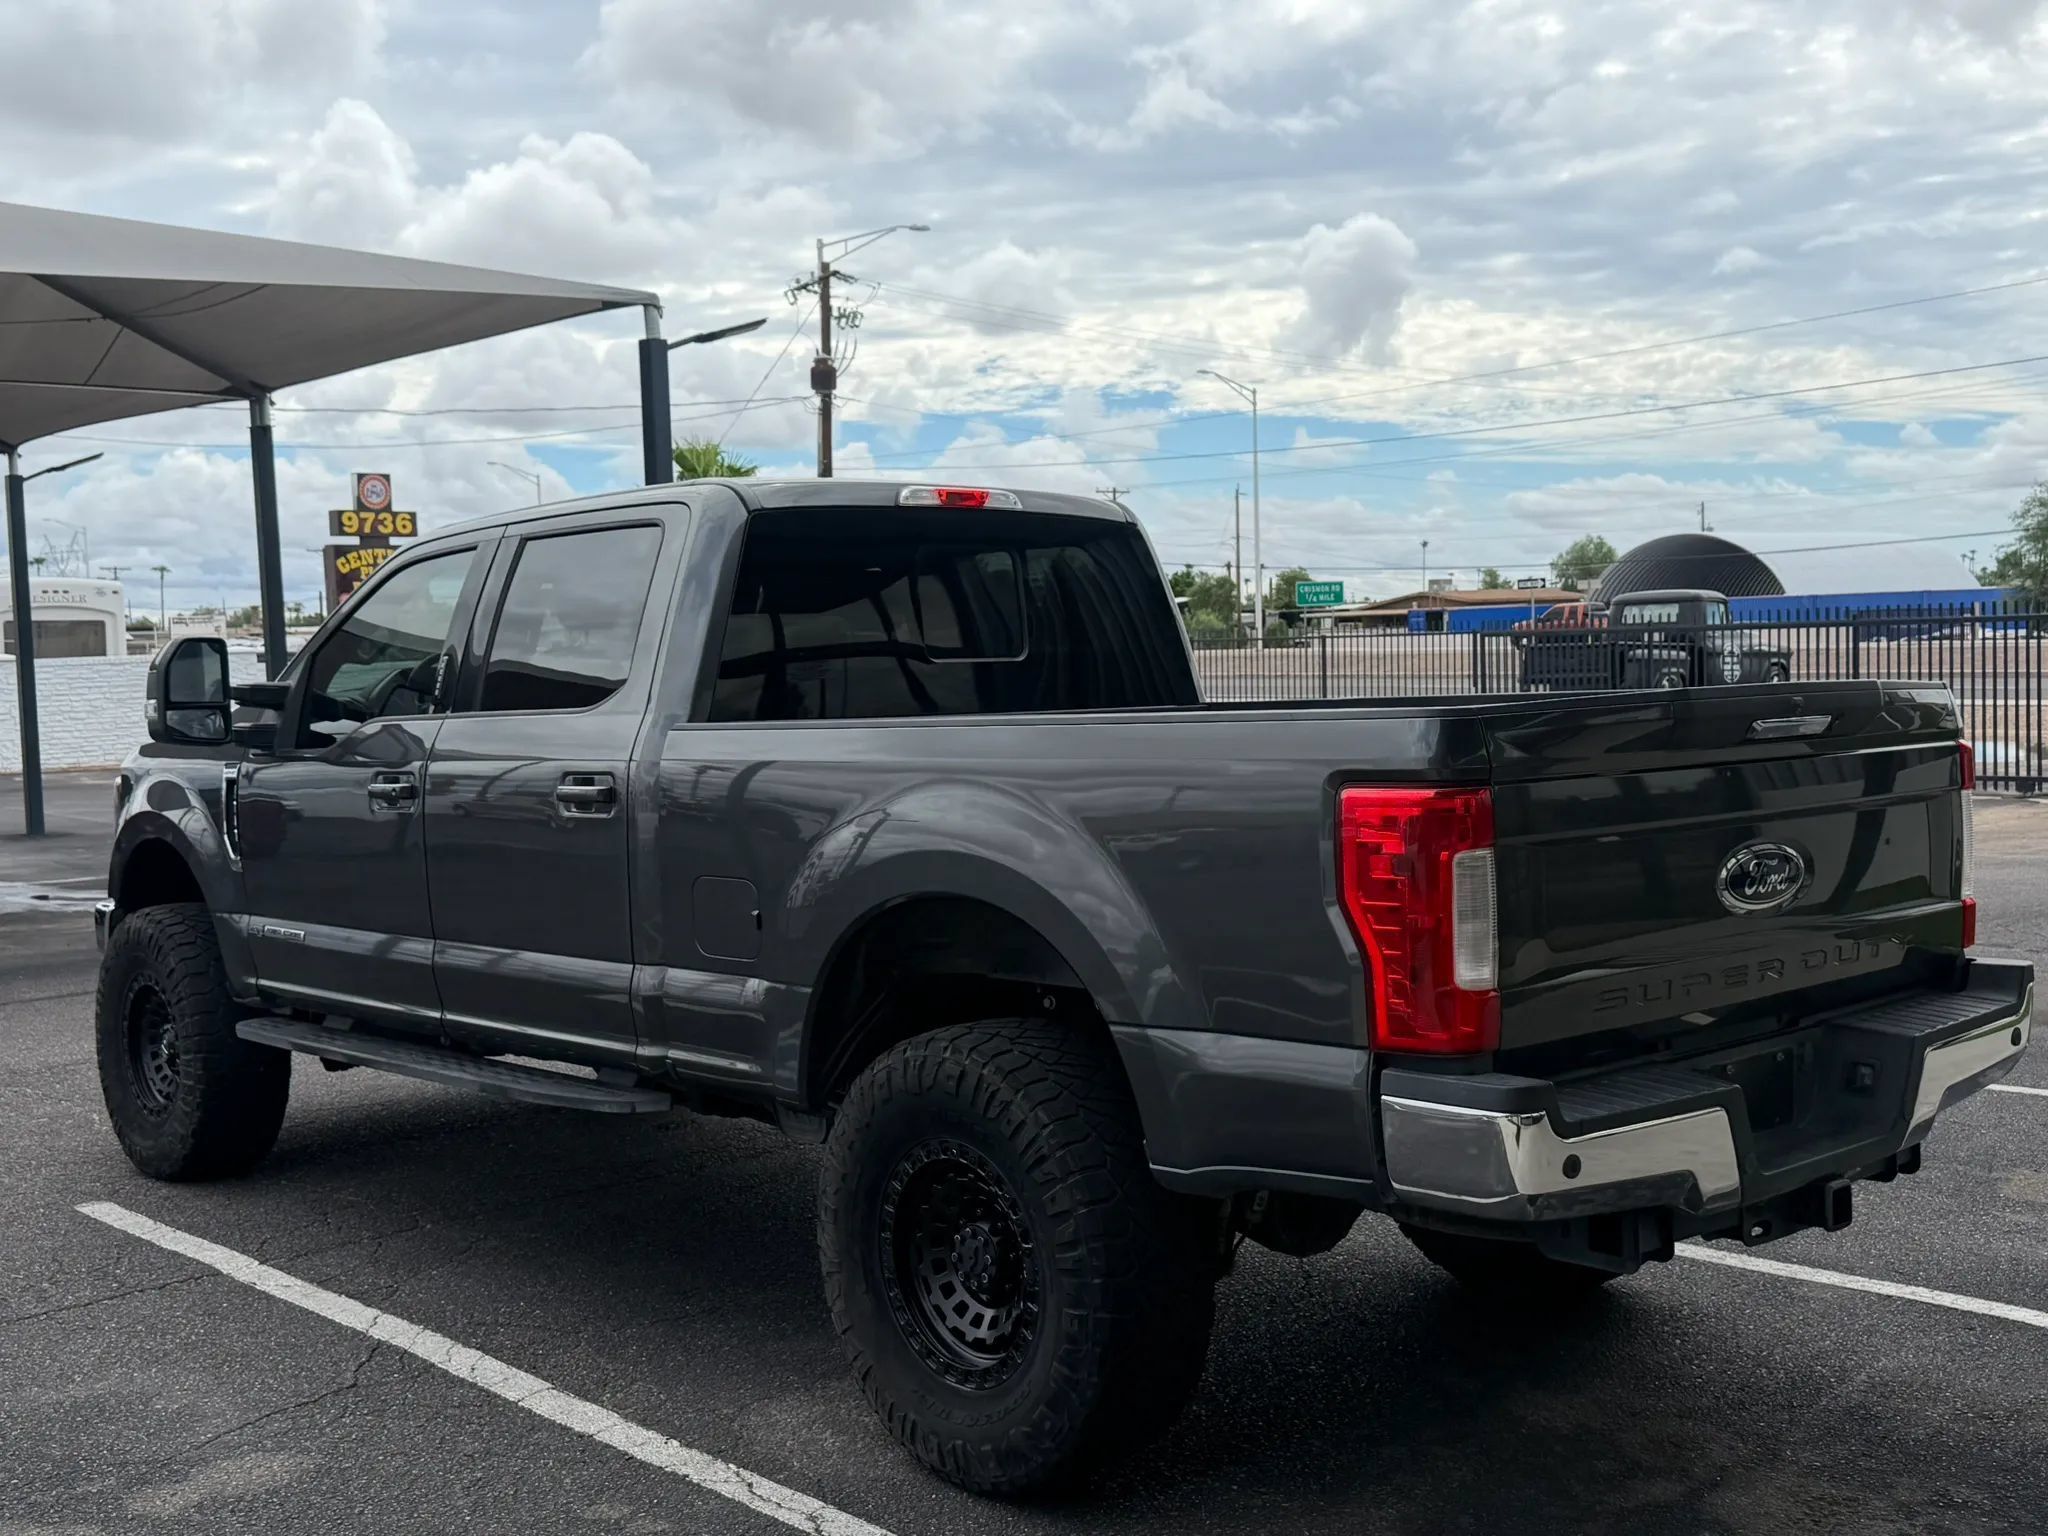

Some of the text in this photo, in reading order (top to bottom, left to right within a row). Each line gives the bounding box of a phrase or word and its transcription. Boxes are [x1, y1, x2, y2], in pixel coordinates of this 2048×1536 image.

[341, 511, 413, 534] 9736
[1331, 584, 1341, 592] RD
[32, 594, 87, 604] ESIGNER
[1318, 593, 1335, 601] MILE
[1744, 858, 1790, 896] Ford
[1593, 934, 1912, 1012] SUPER DUTY
